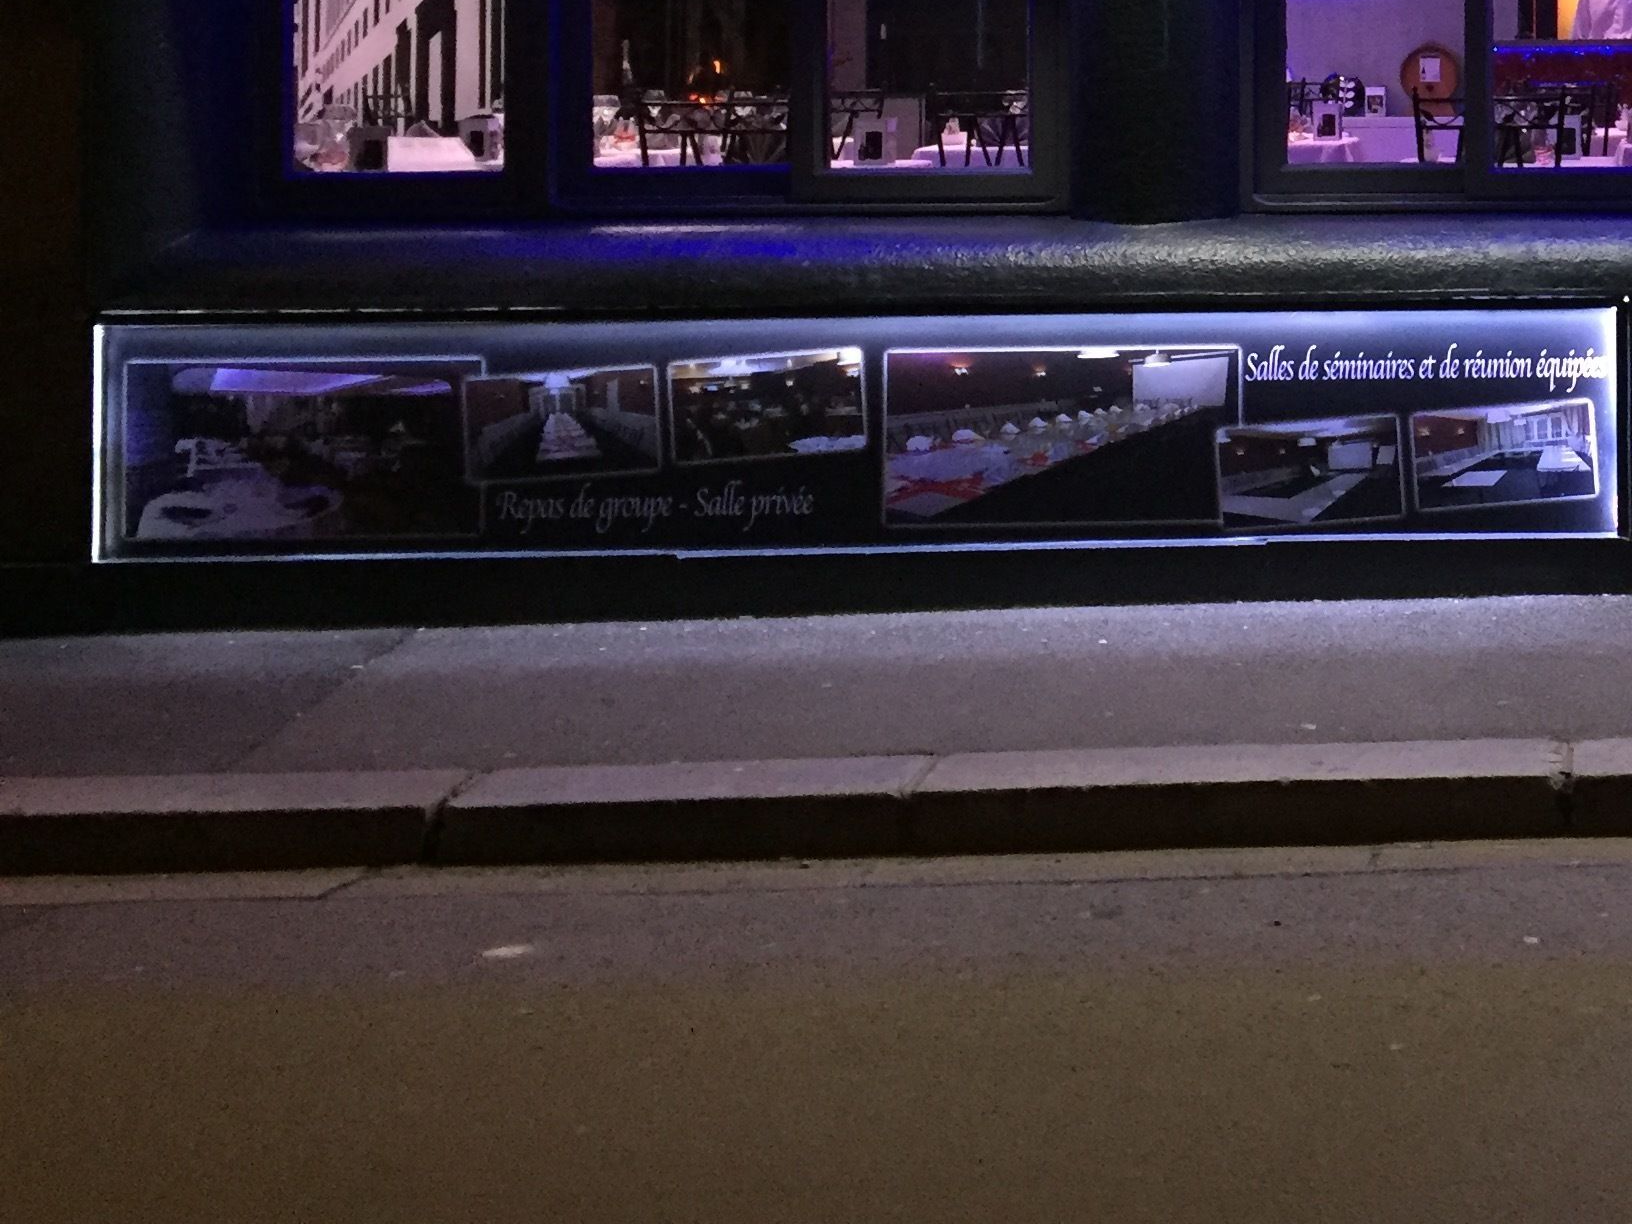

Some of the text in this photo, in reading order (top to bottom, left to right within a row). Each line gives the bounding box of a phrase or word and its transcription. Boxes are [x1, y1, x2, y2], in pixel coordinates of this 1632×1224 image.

[1245, 345, 1294, 381] Salles
[1298, 345, 1320, 380] de
[1322, 351, 1416, 380] séminaires
[1418, 354, 1436, 380] et
[1439, 343, 1458, 380] de
[1463, 350, 1532, 379] réunion
[495, 490, 565, 534] Repas
[569, 482, 595, 520] de
[595, 494, 674, 534] groupe
[693, 479, 744, 518] Salle
[742, 485, 816, 532] privée
